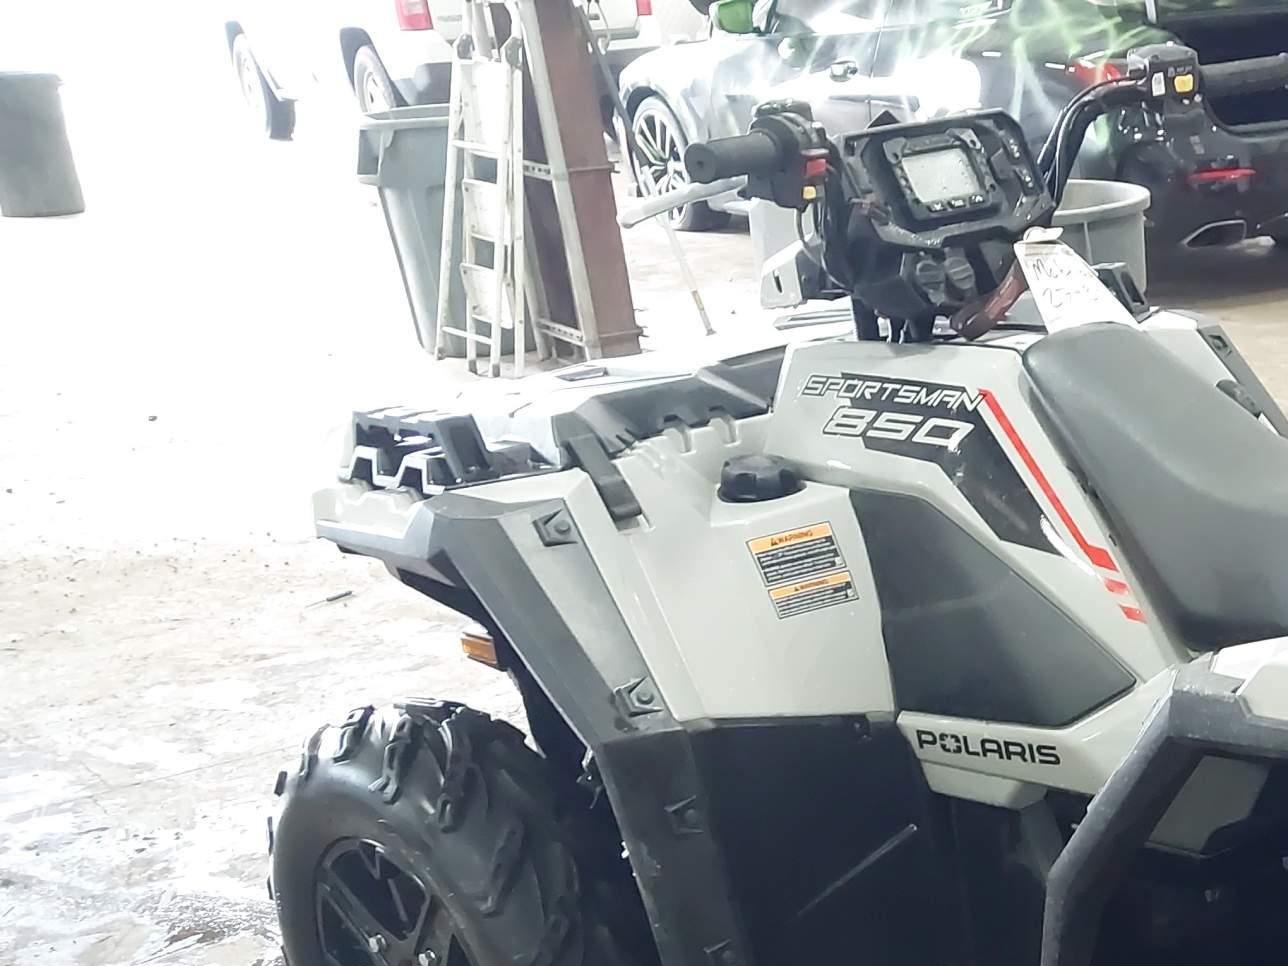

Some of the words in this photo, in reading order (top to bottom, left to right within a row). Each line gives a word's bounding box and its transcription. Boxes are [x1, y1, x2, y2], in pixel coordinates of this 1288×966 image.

[802, 375, 983, 411] SPORTSMAN
[823, 406, 975, 450] 850
[916, 730, 1061, 765] POLARIS
